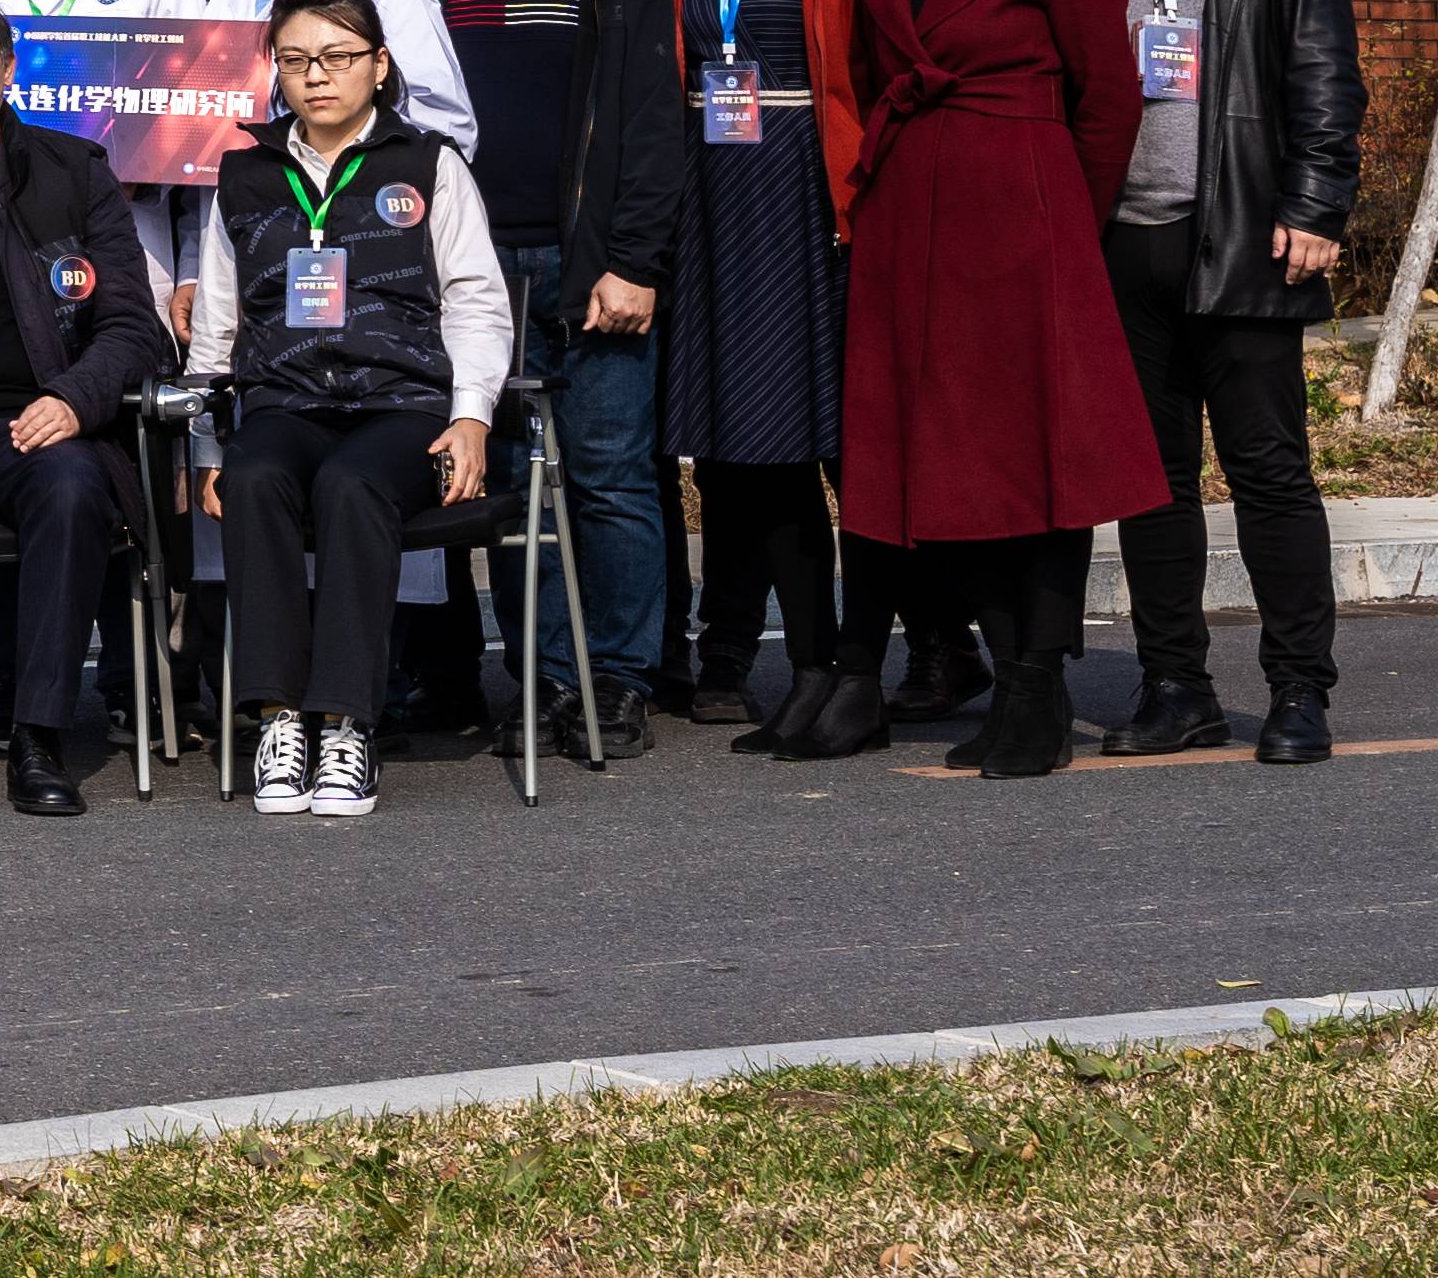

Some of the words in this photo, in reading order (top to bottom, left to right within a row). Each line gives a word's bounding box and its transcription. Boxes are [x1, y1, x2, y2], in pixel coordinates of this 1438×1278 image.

[3, 83, 255, 119] 大连化学物理研究所
[386, 197, 415, 213] BD
[340, 228, 404, 243] DBBTALOSE
[60, 270, 87, 286] BD
